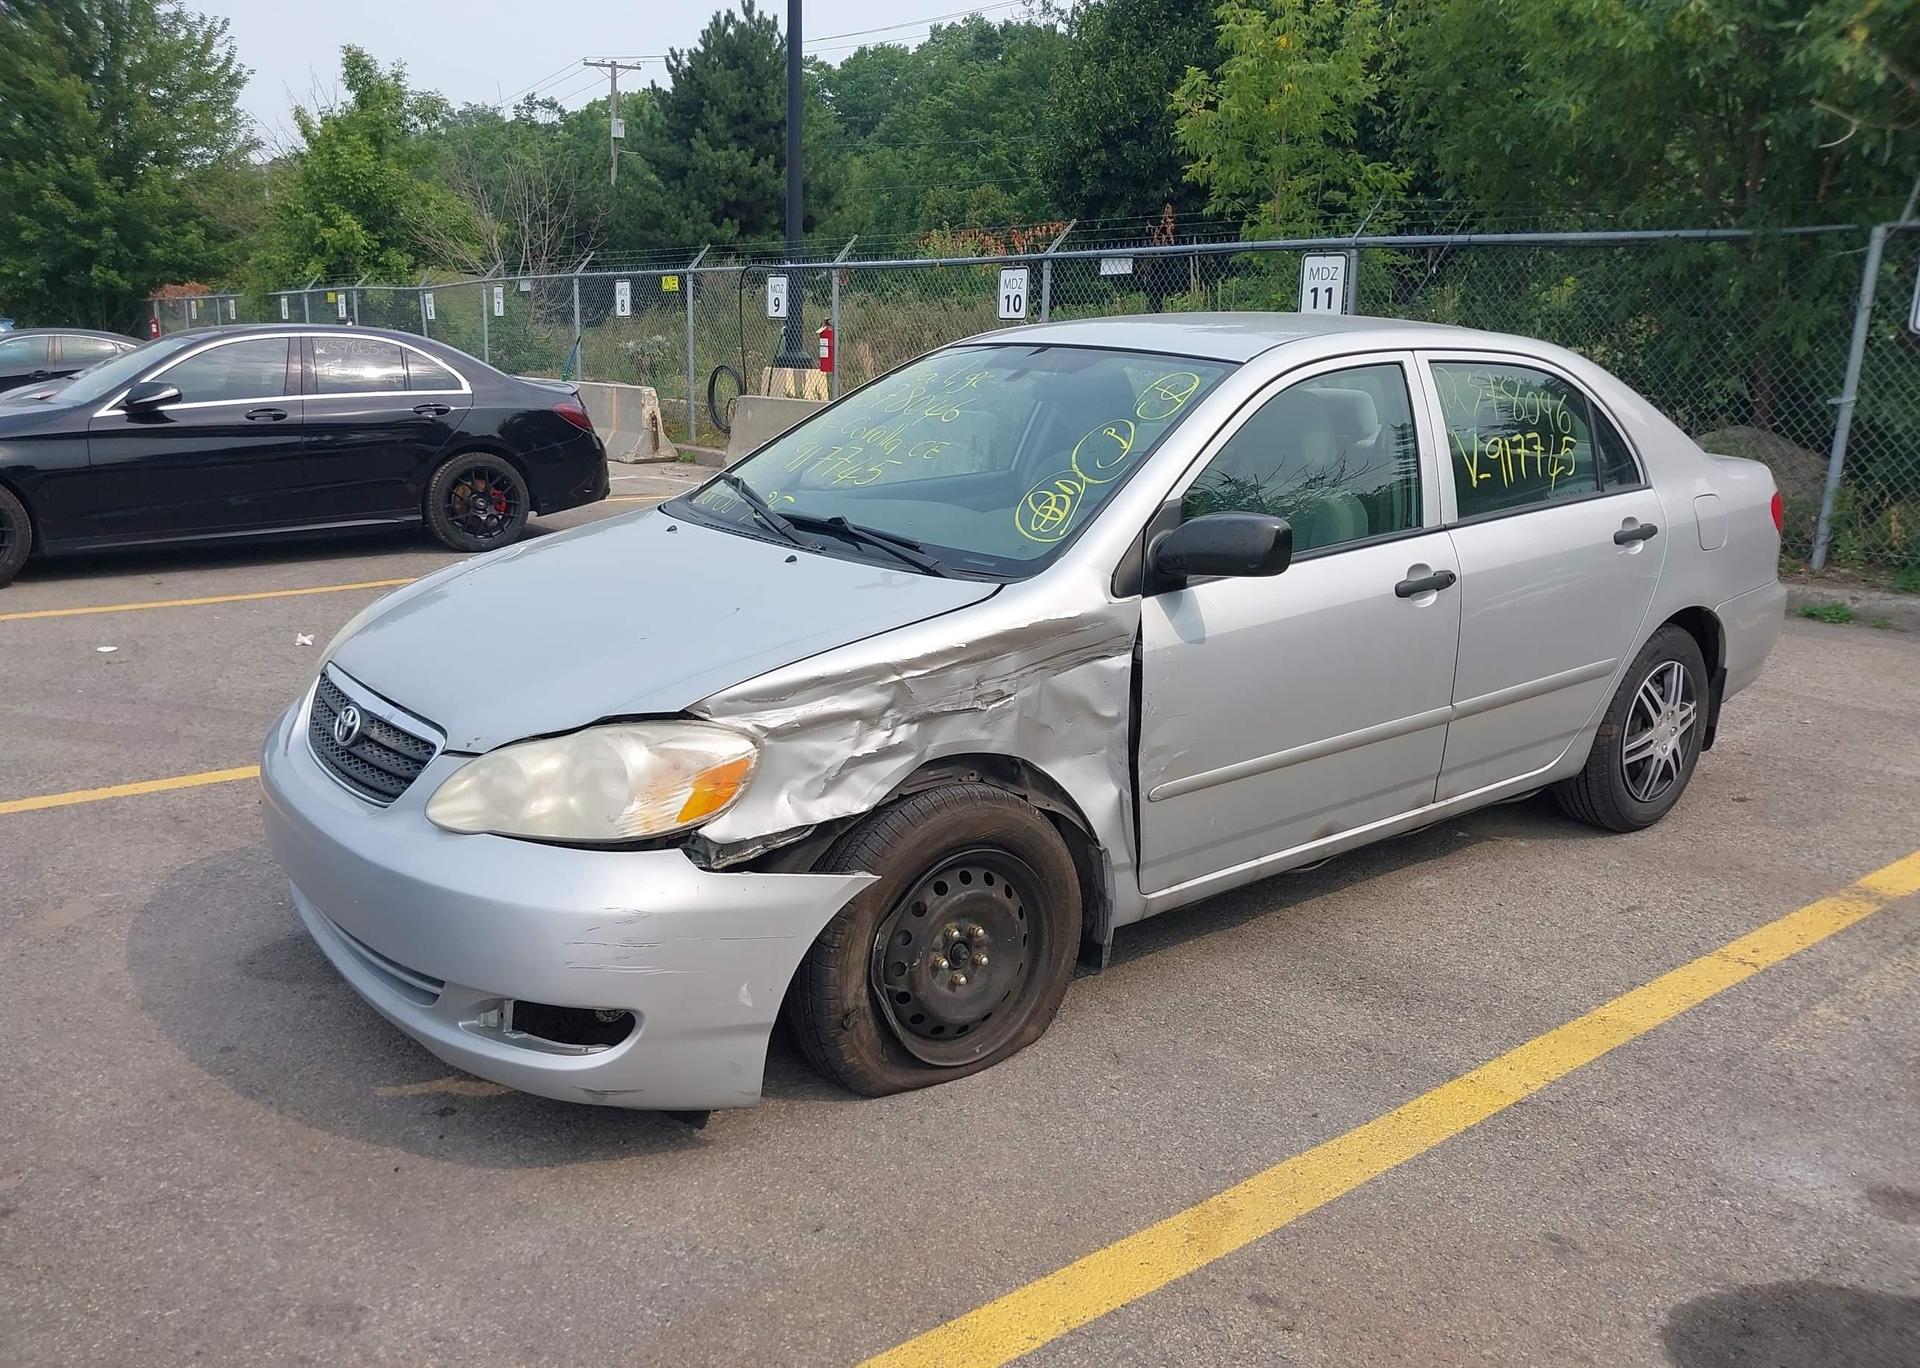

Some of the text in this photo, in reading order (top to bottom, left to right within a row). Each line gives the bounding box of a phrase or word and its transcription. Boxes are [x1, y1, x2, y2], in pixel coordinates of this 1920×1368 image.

[1308, 266, 1339, 281] MDZ
[770, 284, 784, 294] MDZ
[1003, 277, 1024, 290] MDZ
[773, 297, 781, 312] 9
[1004, 294, 1022, 313] 10
[1310, 286, 1334, 310] 11
[496, 301, 501, 314] 7
[620, 299, 626, 312] 8
